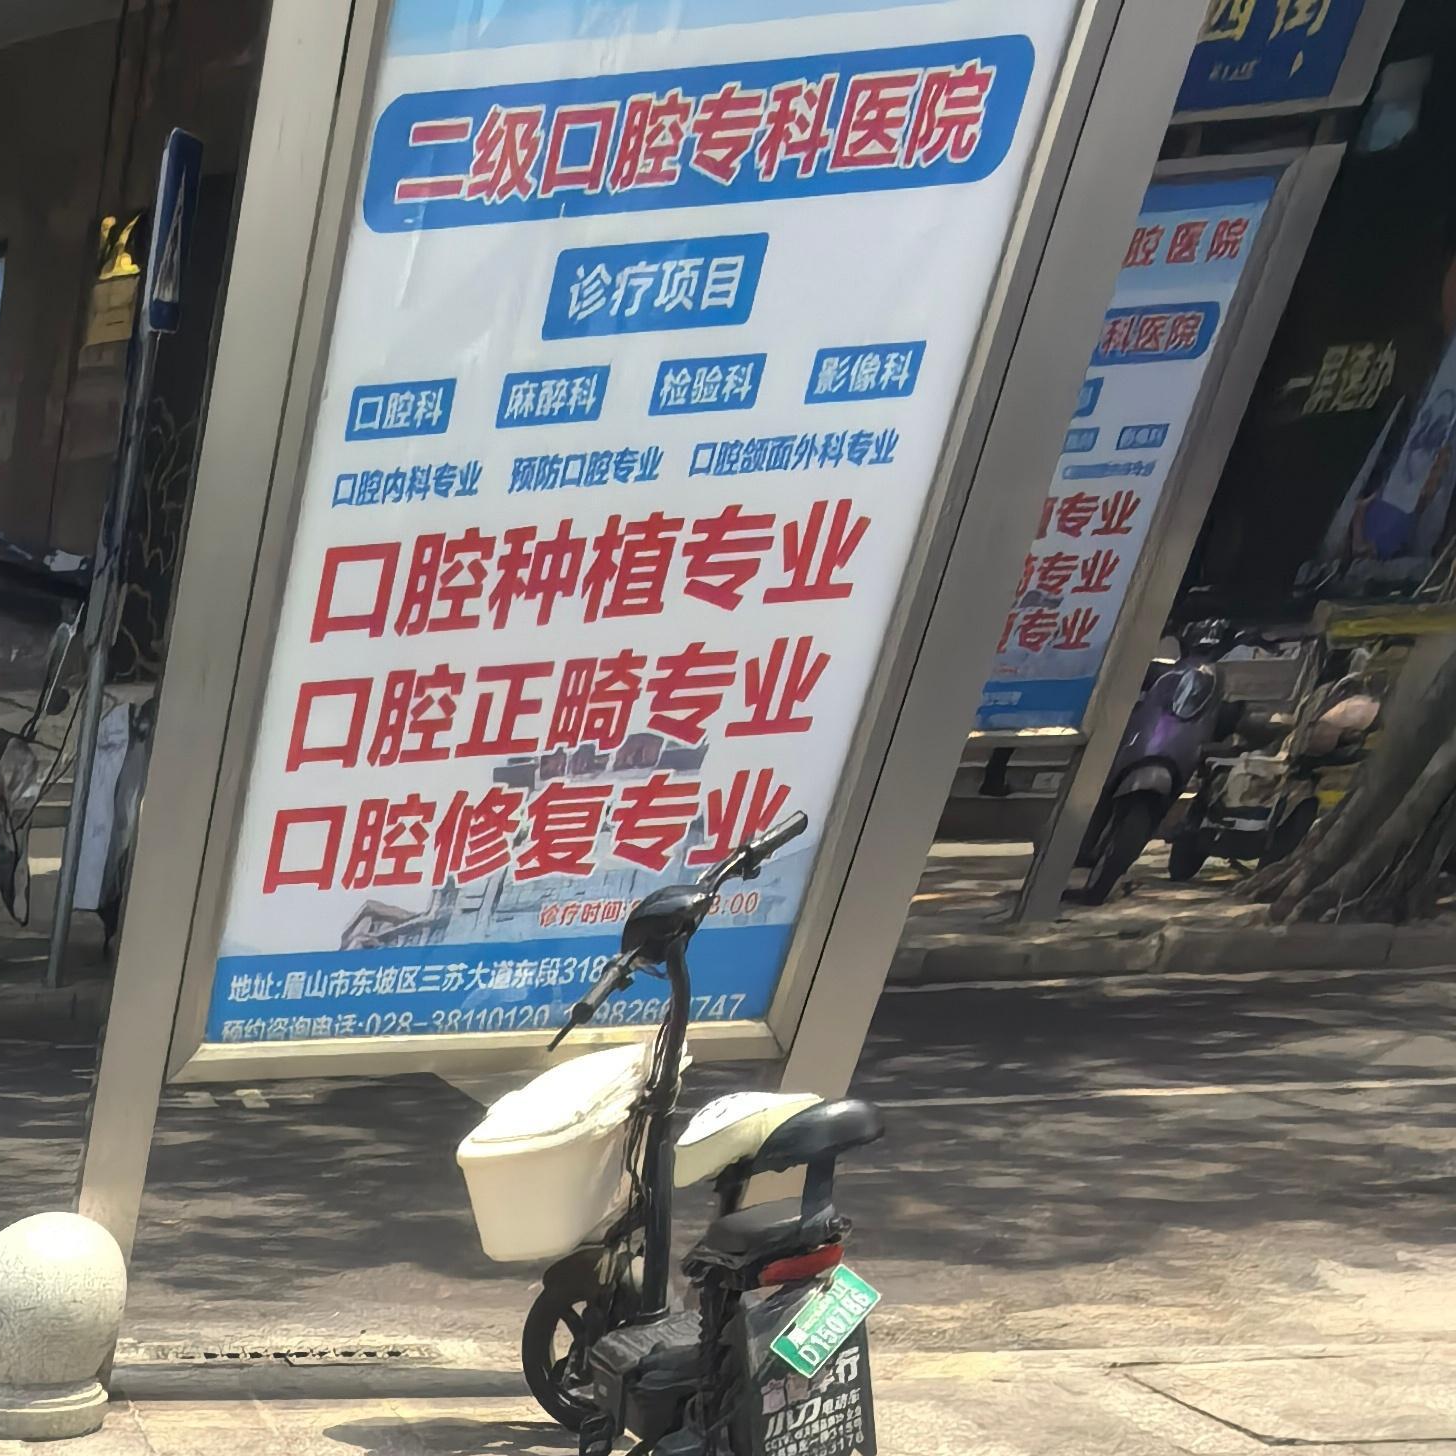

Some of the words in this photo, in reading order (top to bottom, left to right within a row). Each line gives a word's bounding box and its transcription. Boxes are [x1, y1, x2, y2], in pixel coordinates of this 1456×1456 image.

[394, 59, 997, 205] 二级口腔专科医院
[566, 254, 746, 323] 诊疗项目
[352, 388, 444, 432] 口腔科
[503, 370, 599, 420] 麻醉科
[658, 361, 754, 410] 检验科
[813, 347, 913, 397] 影像科
[332, 460, 483, 509] 口腔内科专业
[508, 445, 664, 495] 预防口腔专业
[689, 427, 900, 478] 口腔颌面外科专业
[309, 498, 872, 644] 口腔种植专业
[285, 635, 831, 773] 口腔正畸专业
[263, 767, 791, 895] 口腔修复专业
[228, 955, 610, 1003] 地址:眉山市东坡区三苏大道东段318
